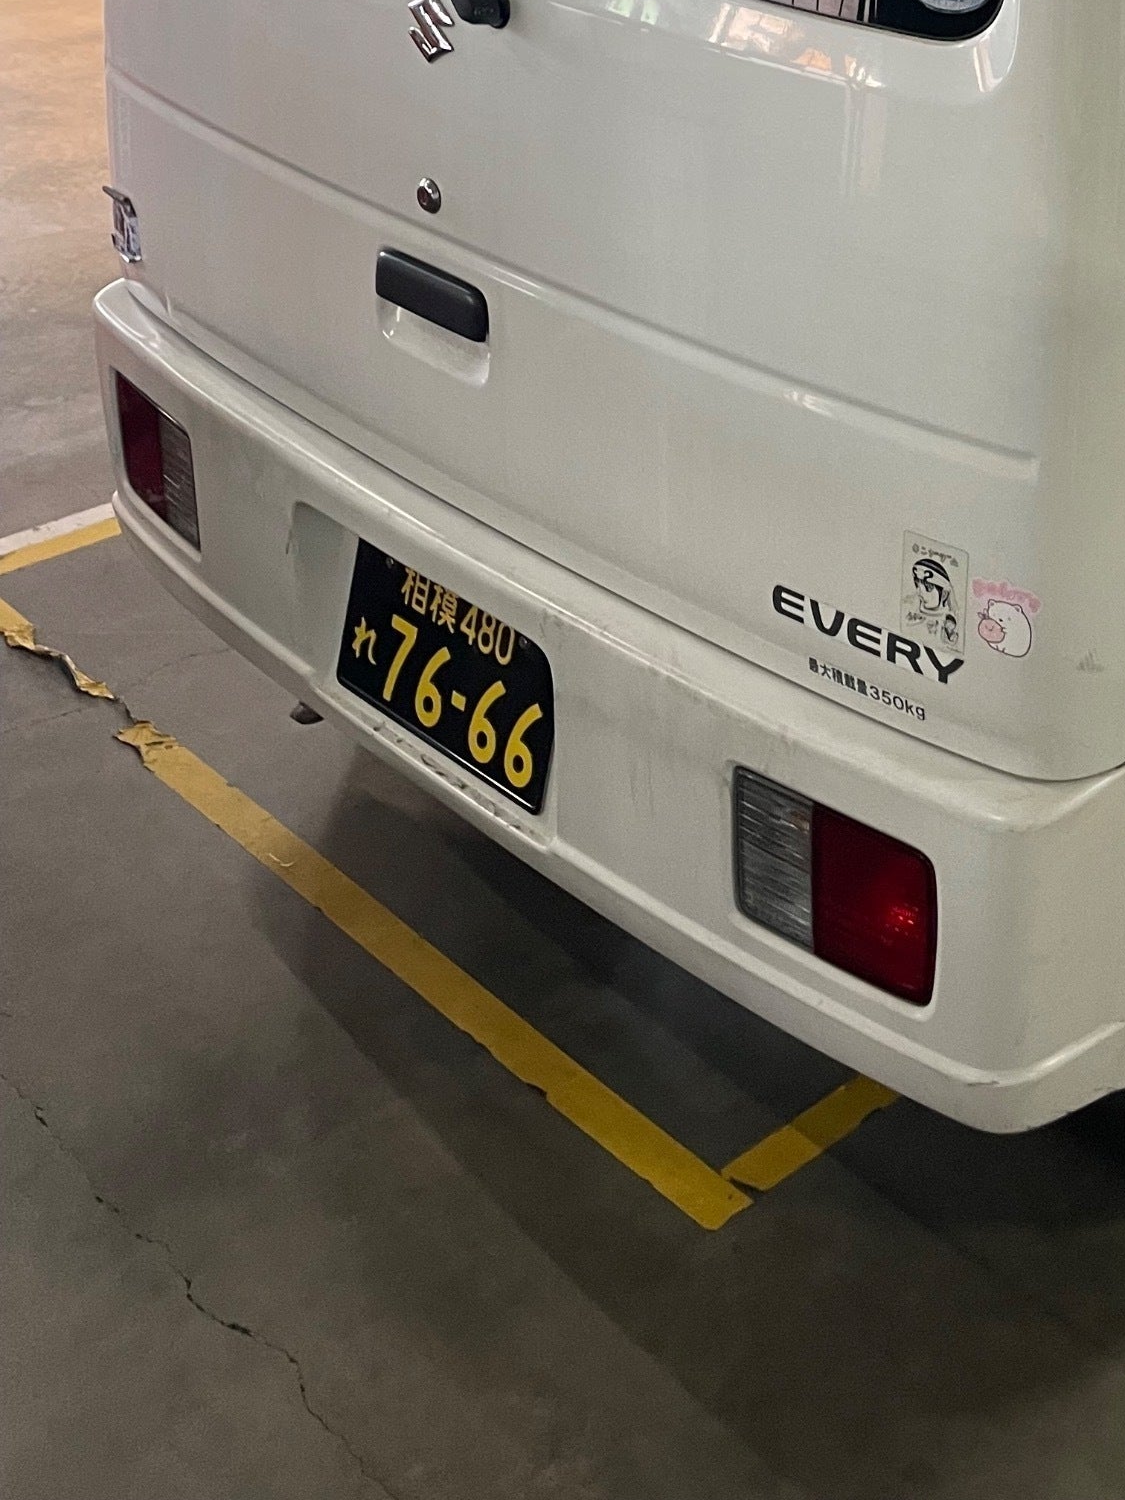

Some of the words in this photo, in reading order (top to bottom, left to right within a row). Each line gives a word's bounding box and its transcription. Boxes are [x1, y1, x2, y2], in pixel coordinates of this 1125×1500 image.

[351, 615, 378, 666] れ
[401, 566, 459, 634] 相模
[459, 604, 516, 666] 480
[771, 584, 965, 685] EVERY
